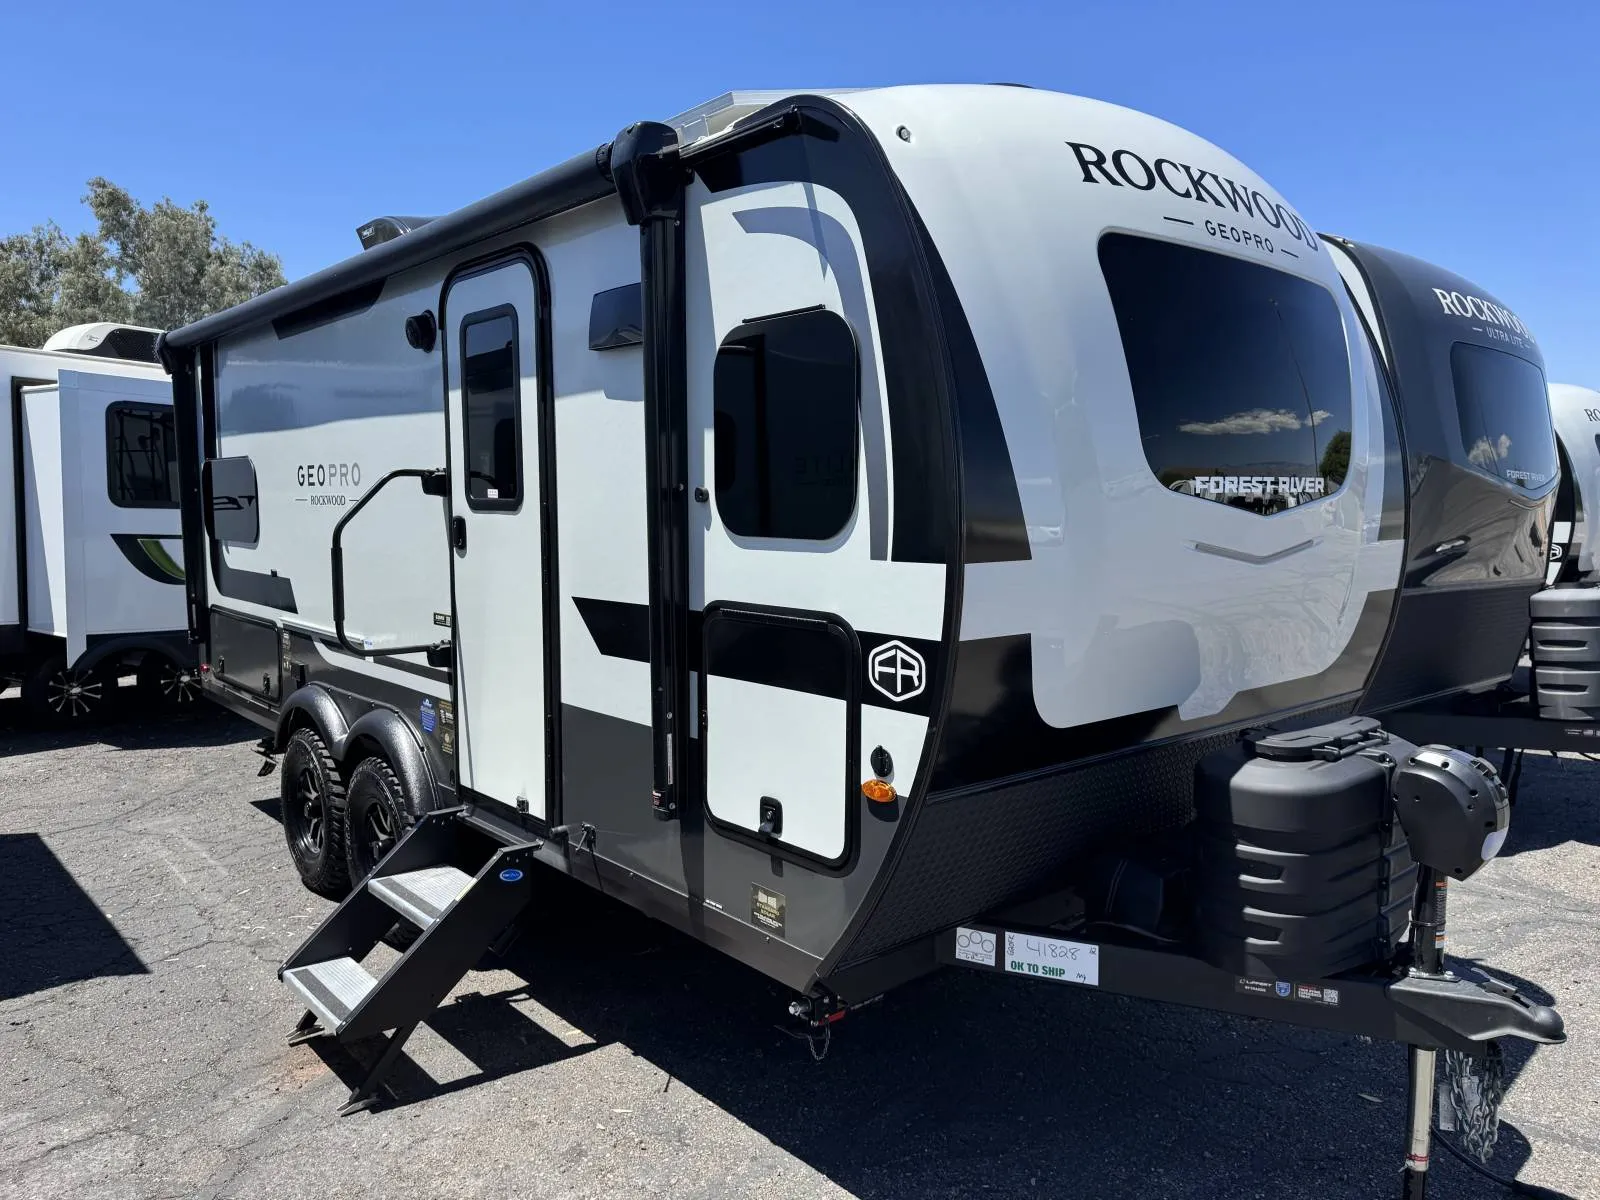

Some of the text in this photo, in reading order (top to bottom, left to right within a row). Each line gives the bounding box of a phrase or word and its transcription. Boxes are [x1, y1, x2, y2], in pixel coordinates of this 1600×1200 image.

[1065, 141, 1319, 251] ROCKWOOD
[1204, 219, 1274, 253] GEOPRO
[297, 462, 361, 487] GEOPRO
[1195, 475, 1325, 494] FOREST RIVER
[310, 495, 346, 506] ROCKWOOD
[1026, 939, 1081, 961] 41828
[1010, 960, 1066, 977] OK TO SHIP
